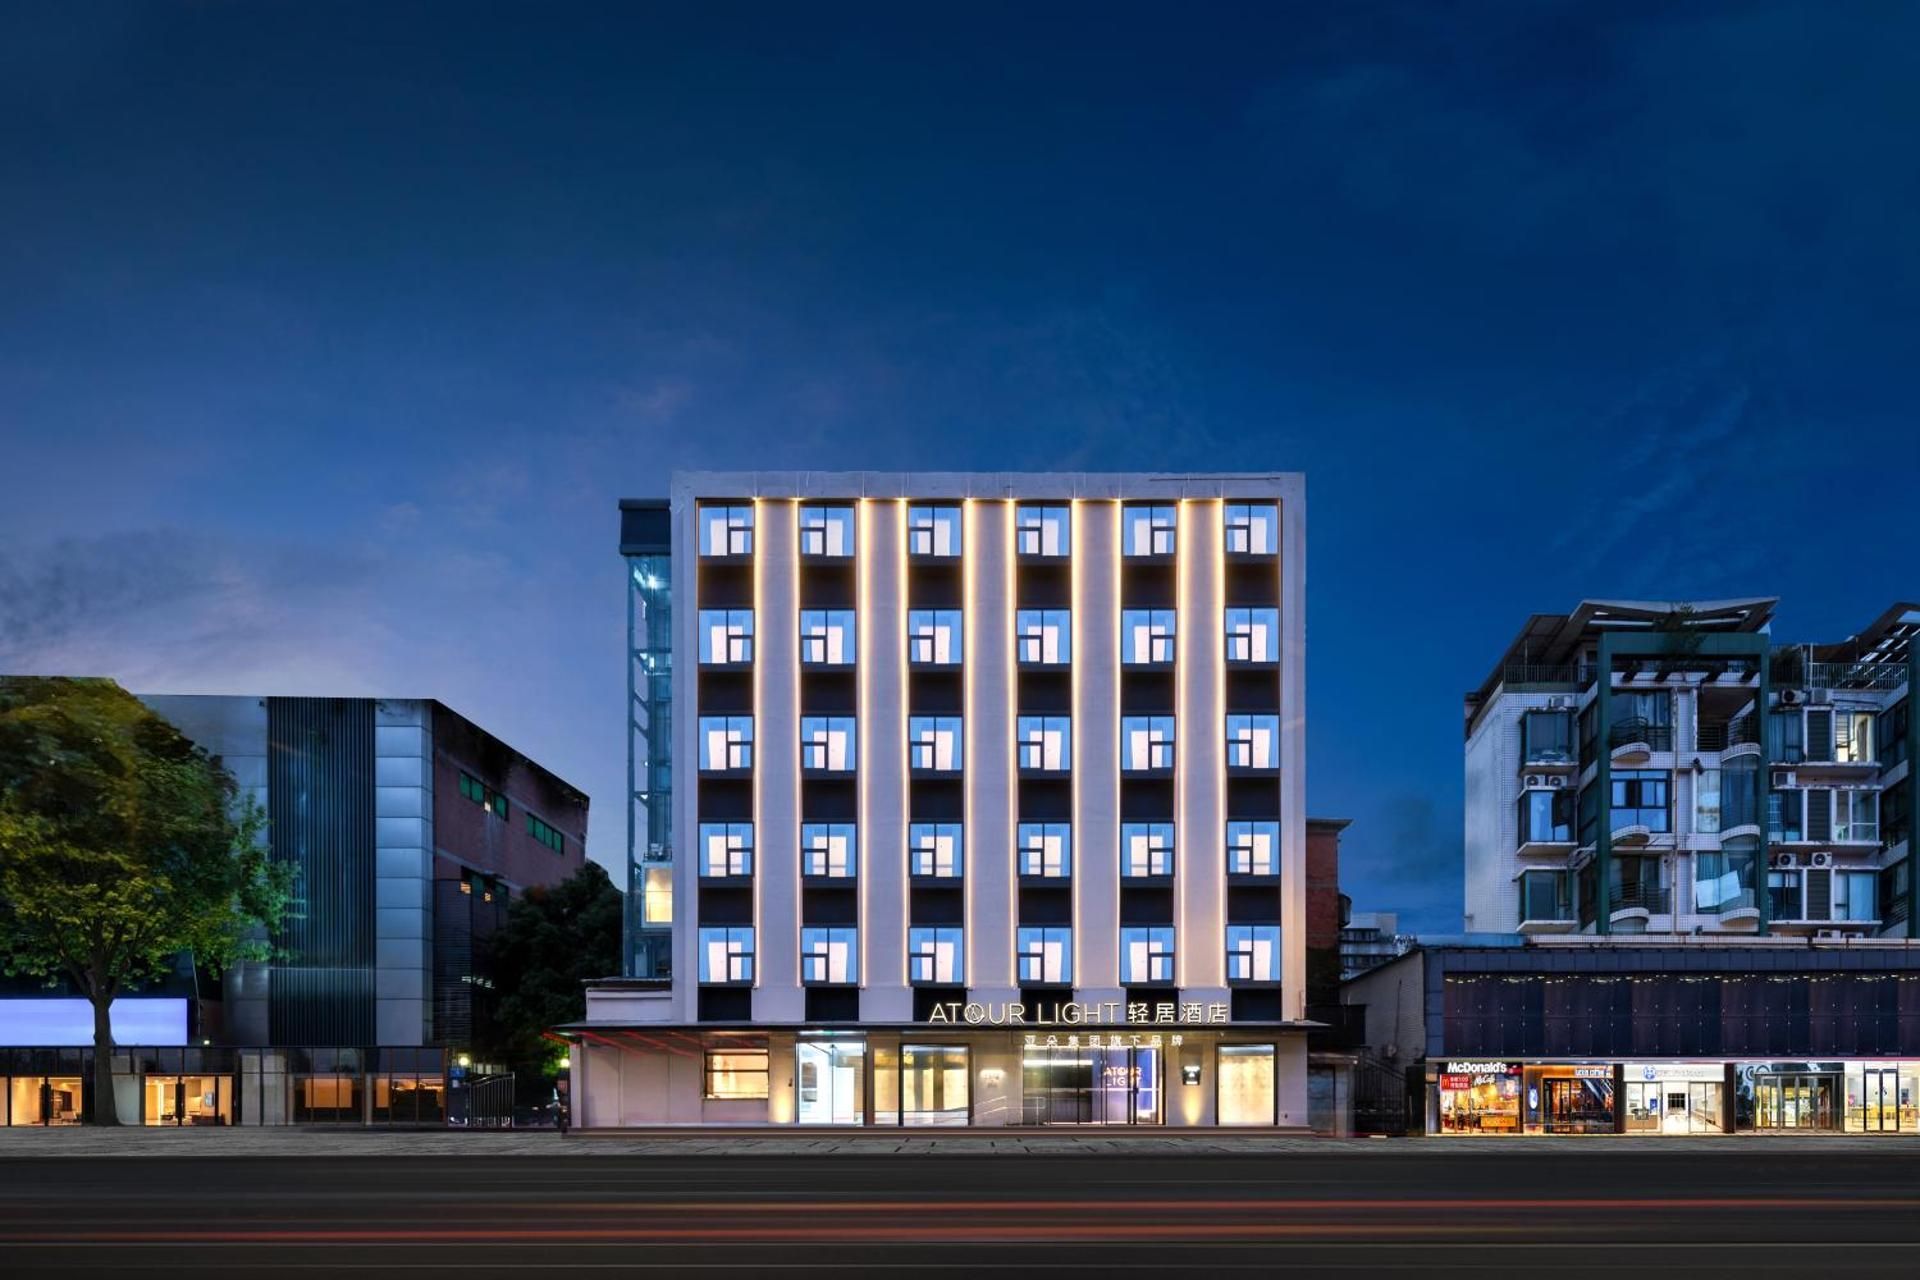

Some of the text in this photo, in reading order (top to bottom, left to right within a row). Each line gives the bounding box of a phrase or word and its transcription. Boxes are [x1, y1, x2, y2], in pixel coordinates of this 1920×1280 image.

[929, 1001, 1229, 1024] ATOUR LIGHT 轻居酒店
[1447, 1061, 1508, 1073] McDonald's
